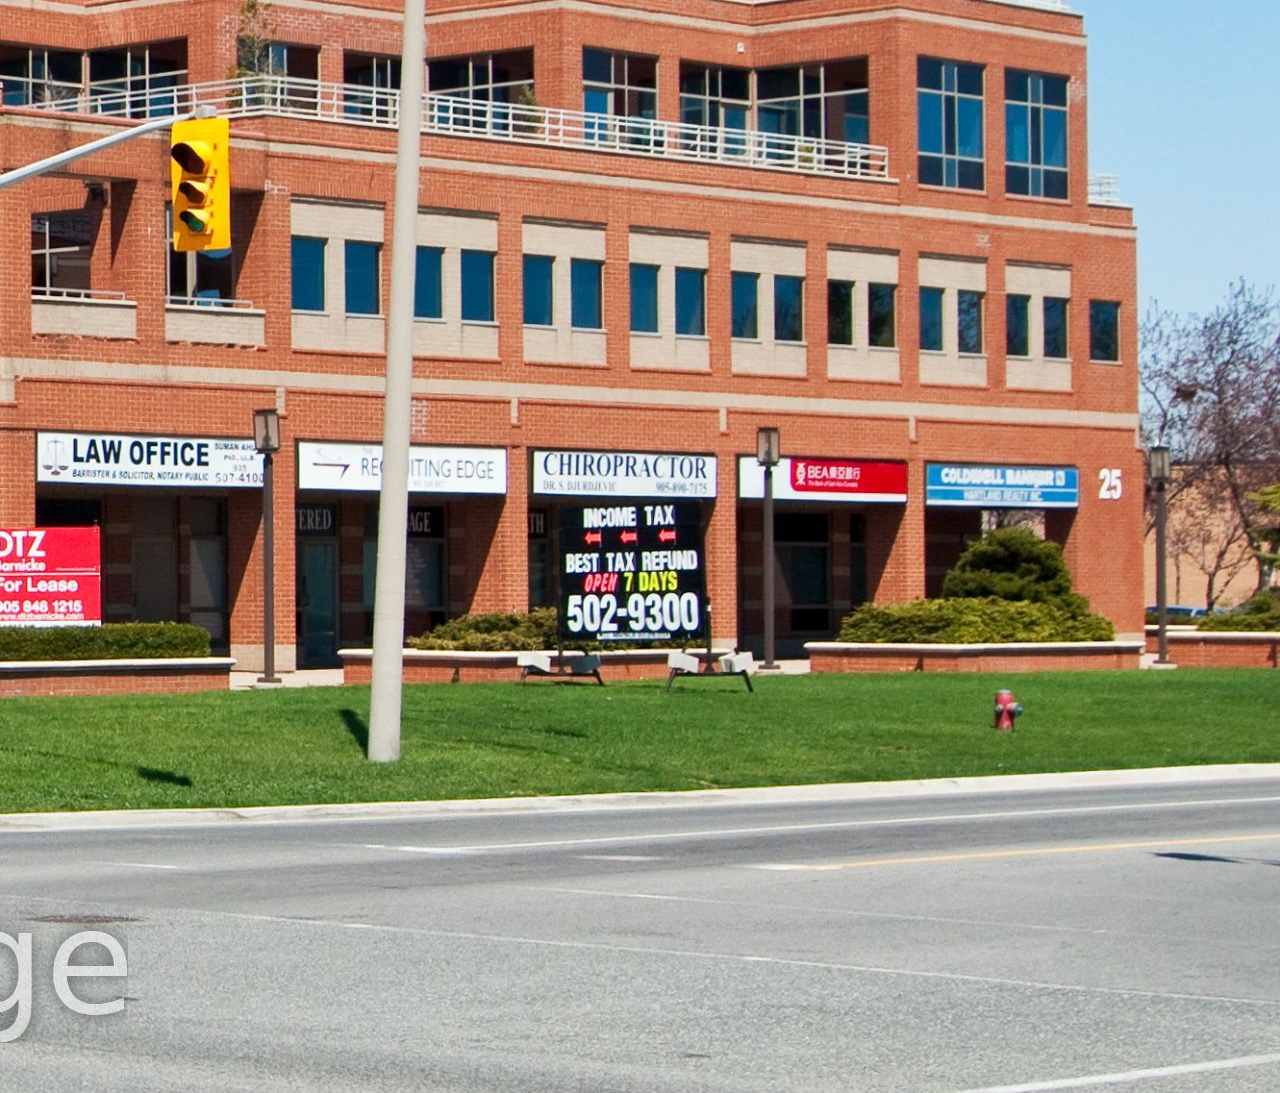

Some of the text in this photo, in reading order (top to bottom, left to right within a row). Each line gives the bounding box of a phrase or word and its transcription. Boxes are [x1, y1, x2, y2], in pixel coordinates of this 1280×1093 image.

[73, 438, 209, 467] LAW OFFICE
[361, 457, 495, 479] REITING EDGE
[543, 452, 707, 479] CHIROPRACTOR
[808, 465, 828, 479] BEA
[941, 467, 1004, 484] COLDWELL
[1098, 468, 1122, 500] 25
[584, 505, 674, 528] INCOME TAX
[565, 550, 698, 573] BEST TAX REFUND
[27, 577, 78, 592] Lease
[584, 571, 678, 592] OPEN 7 DAYS
[22, 600, 48, 613] 848
[52, 600, 82, 613] 1215
[567, 592, 699, 632] 502-9300
